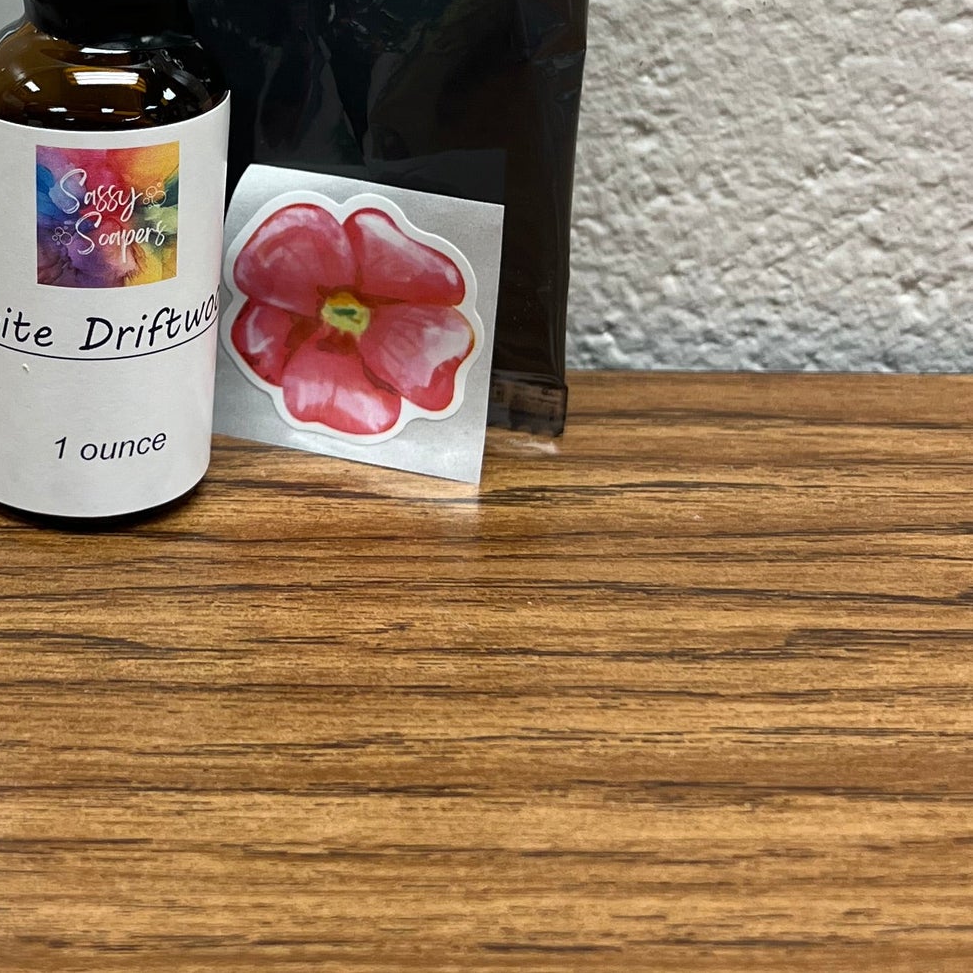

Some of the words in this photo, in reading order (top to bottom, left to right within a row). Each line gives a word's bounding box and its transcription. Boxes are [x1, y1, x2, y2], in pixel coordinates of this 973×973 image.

[60, 168, 146, 222] Sassy
[75, 211, 166, 264] Soapers
[54, 436, 67, 459] 1
[80, 431, 168, 462] ounce
